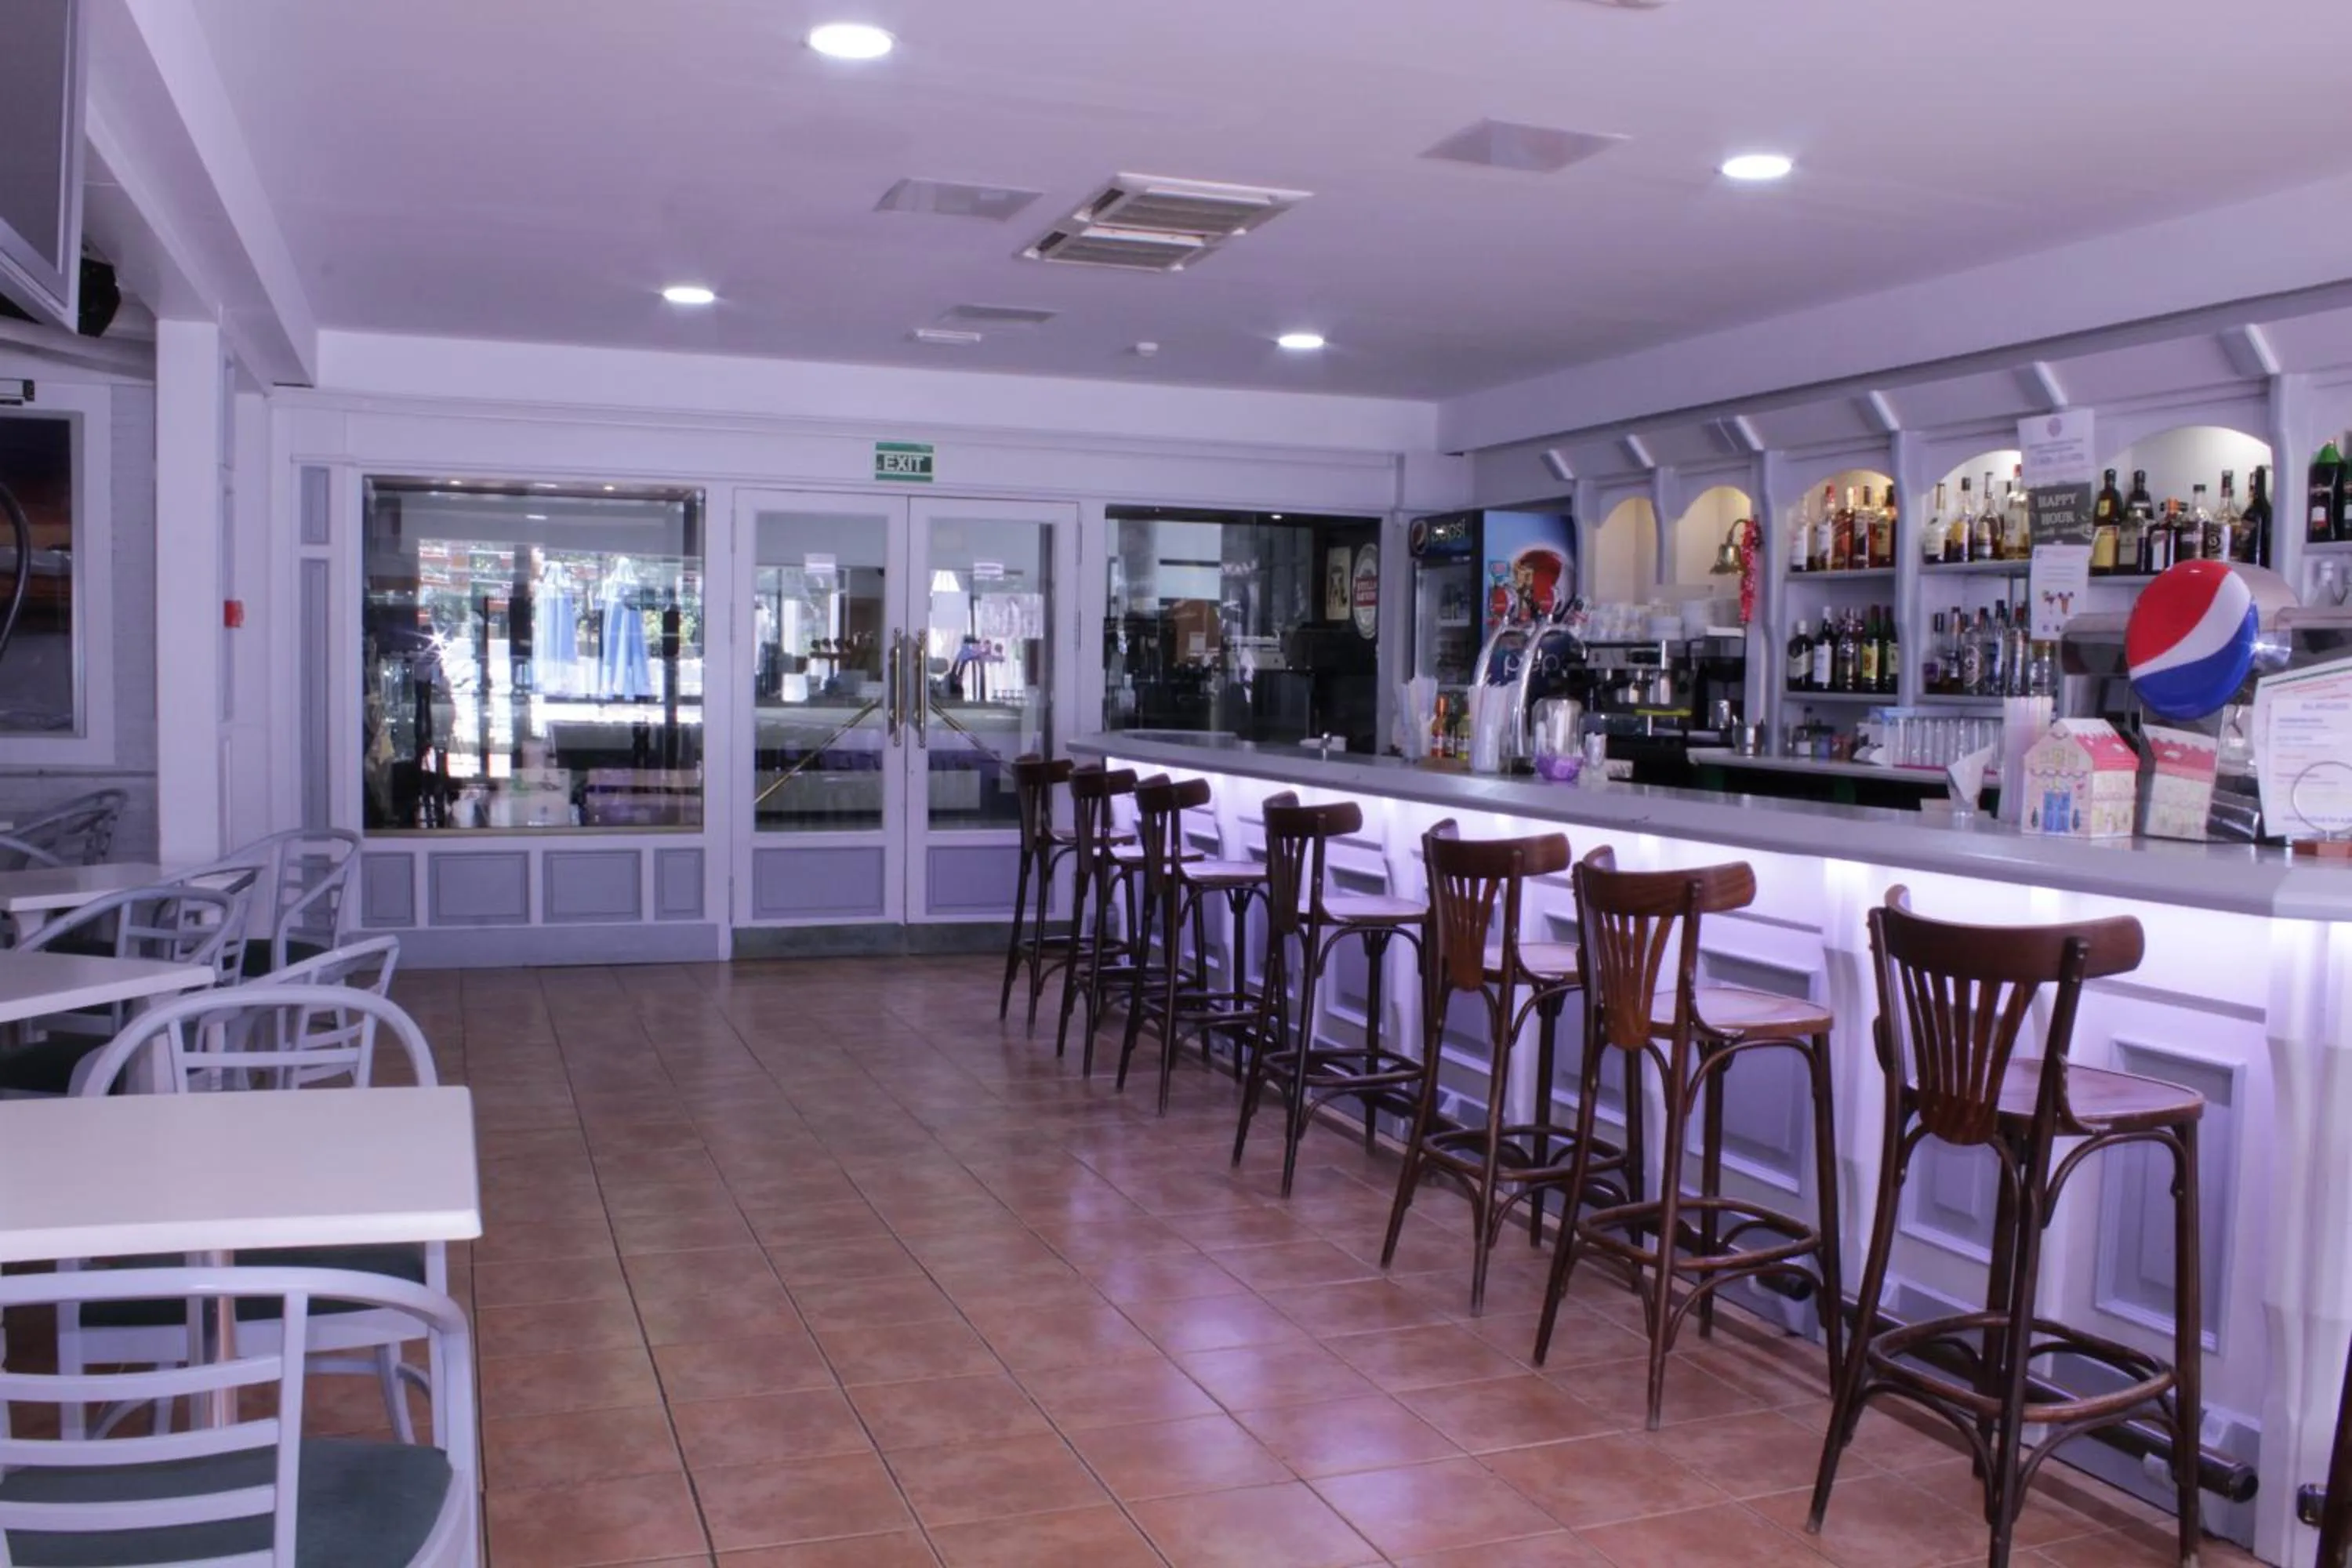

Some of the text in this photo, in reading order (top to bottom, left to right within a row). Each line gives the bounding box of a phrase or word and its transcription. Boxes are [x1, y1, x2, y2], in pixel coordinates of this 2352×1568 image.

[884, 456, 924, 472] EXIT
[2038, 492, 2077, 508] HAPPY
[2041, 510, 2075, 525] HOUR
